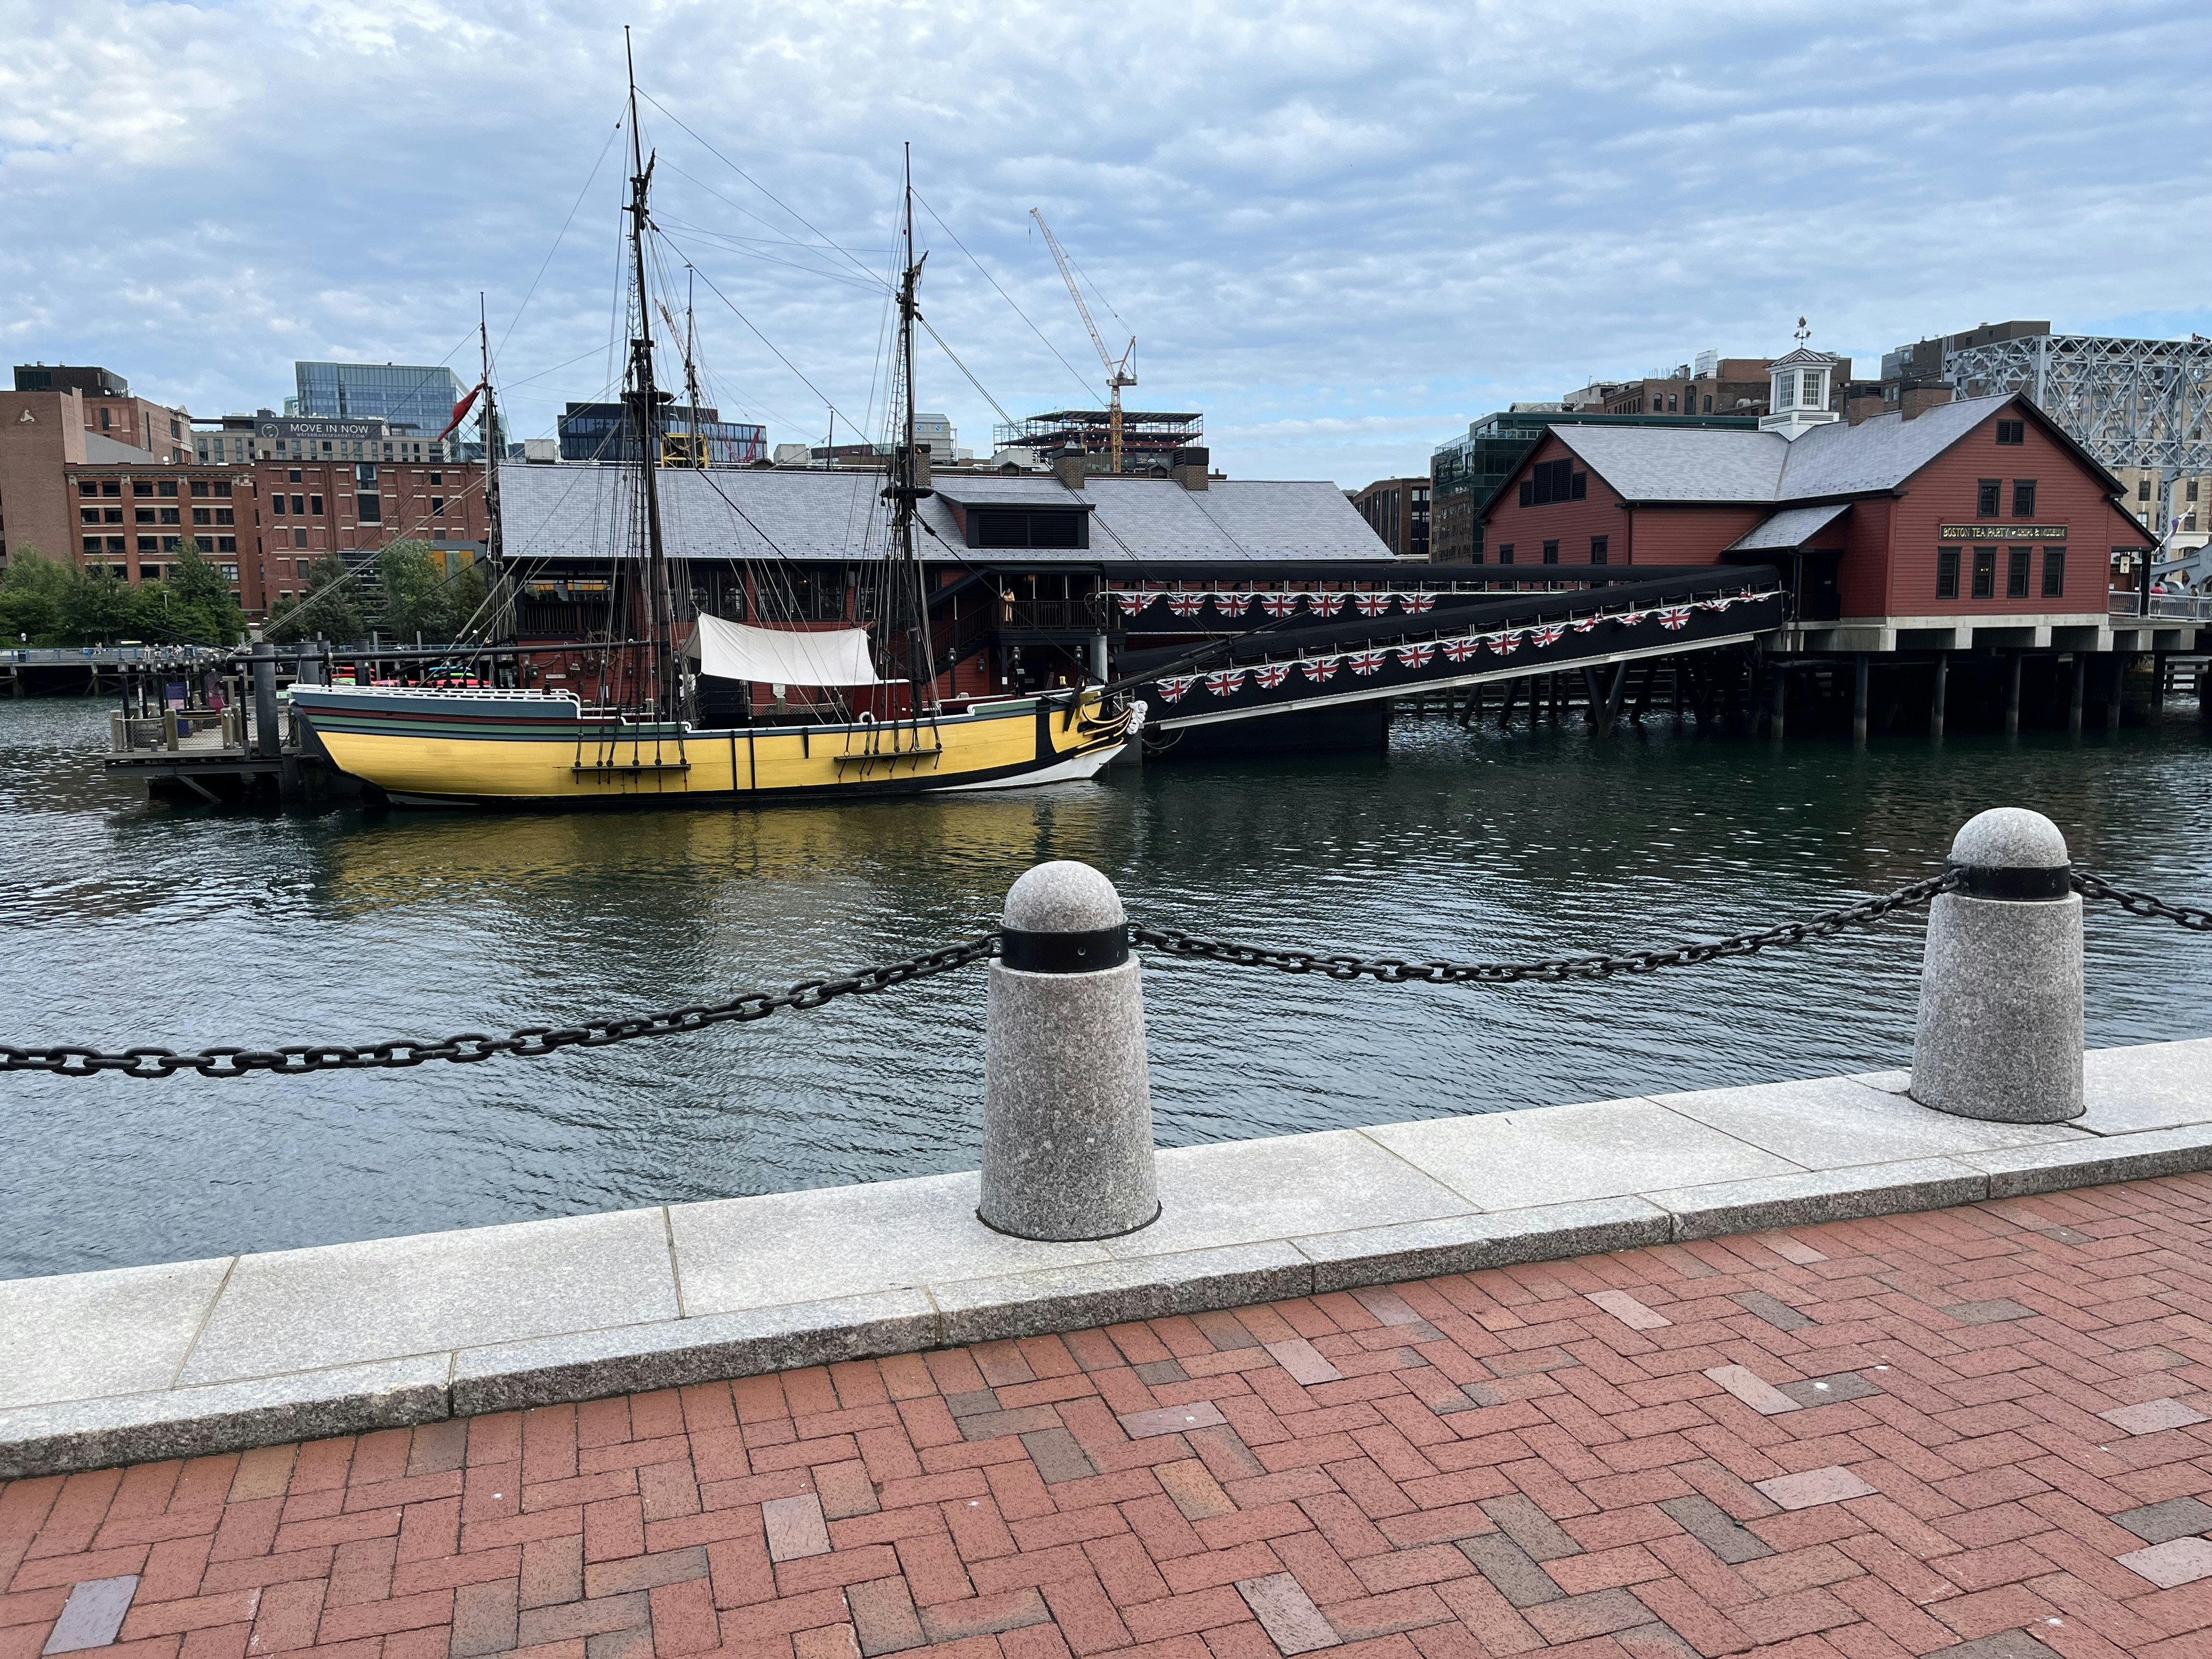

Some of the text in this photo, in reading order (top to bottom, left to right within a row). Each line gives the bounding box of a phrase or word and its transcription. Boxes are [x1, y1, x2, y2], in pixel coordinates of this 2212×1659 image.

[290, 424, 369, 433] MOVE IN NOW
[1943, 527, 1970, 537] BOSTON
[1972, 527, 1985, 537] TEA
[1987, 527, 2010, 537] PARTY
[2017, 528, 2033, 537] SHIPS
[2040, 528, 2065, 537] MUSEUM
